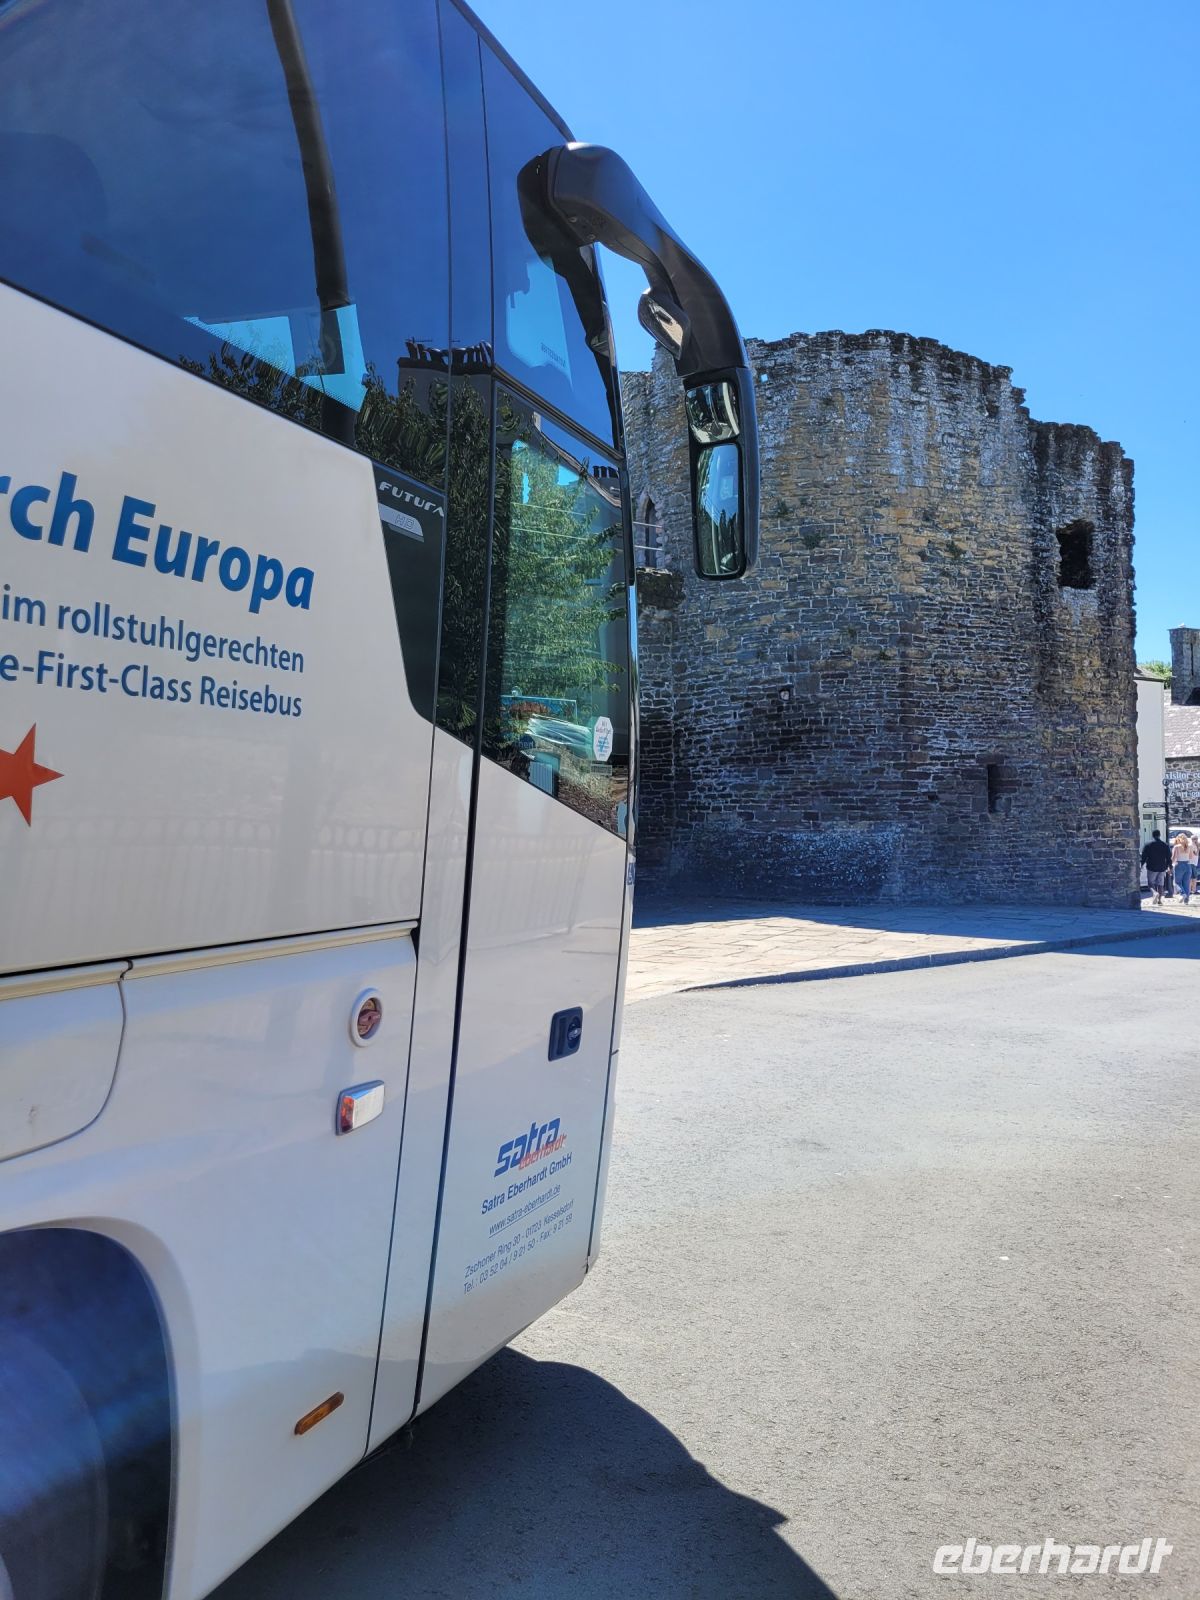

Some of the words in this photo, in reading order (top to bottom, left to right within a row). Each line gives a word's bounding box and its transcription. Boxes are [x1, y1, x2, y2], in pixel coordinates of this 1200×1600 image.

[379, 481, 445, 518] FUTURA
[112, 495, 314, 613] Europa
[2, 583, 46, 626] im
[58, 602, 304, 673] rollstuhlgerechten
[0, 650, 191, 703] e-First-Class
[200, 675, 302, 717] Reisebus
[494, 1118, 561, 1178] satra
[481, 1196, 505, 1215] Satra
[507, 1170, 547, 1199] Eberhardt
[550, 1152, 573, 1175] GmbH
[489, 1184, 561, 1235] www.satra-eberhardt.de
[479, 1269, 489, 1284] 03
[489, 1262, 499, 1277] 52
[500, 1257, 507, 1270] 04
[513, 1250, 518, 1261] 9
[527, 1237, 536, 1251] 50
[498, 1241, 512, 1258] Ring
[512, 1233, 521, 1247] 30
